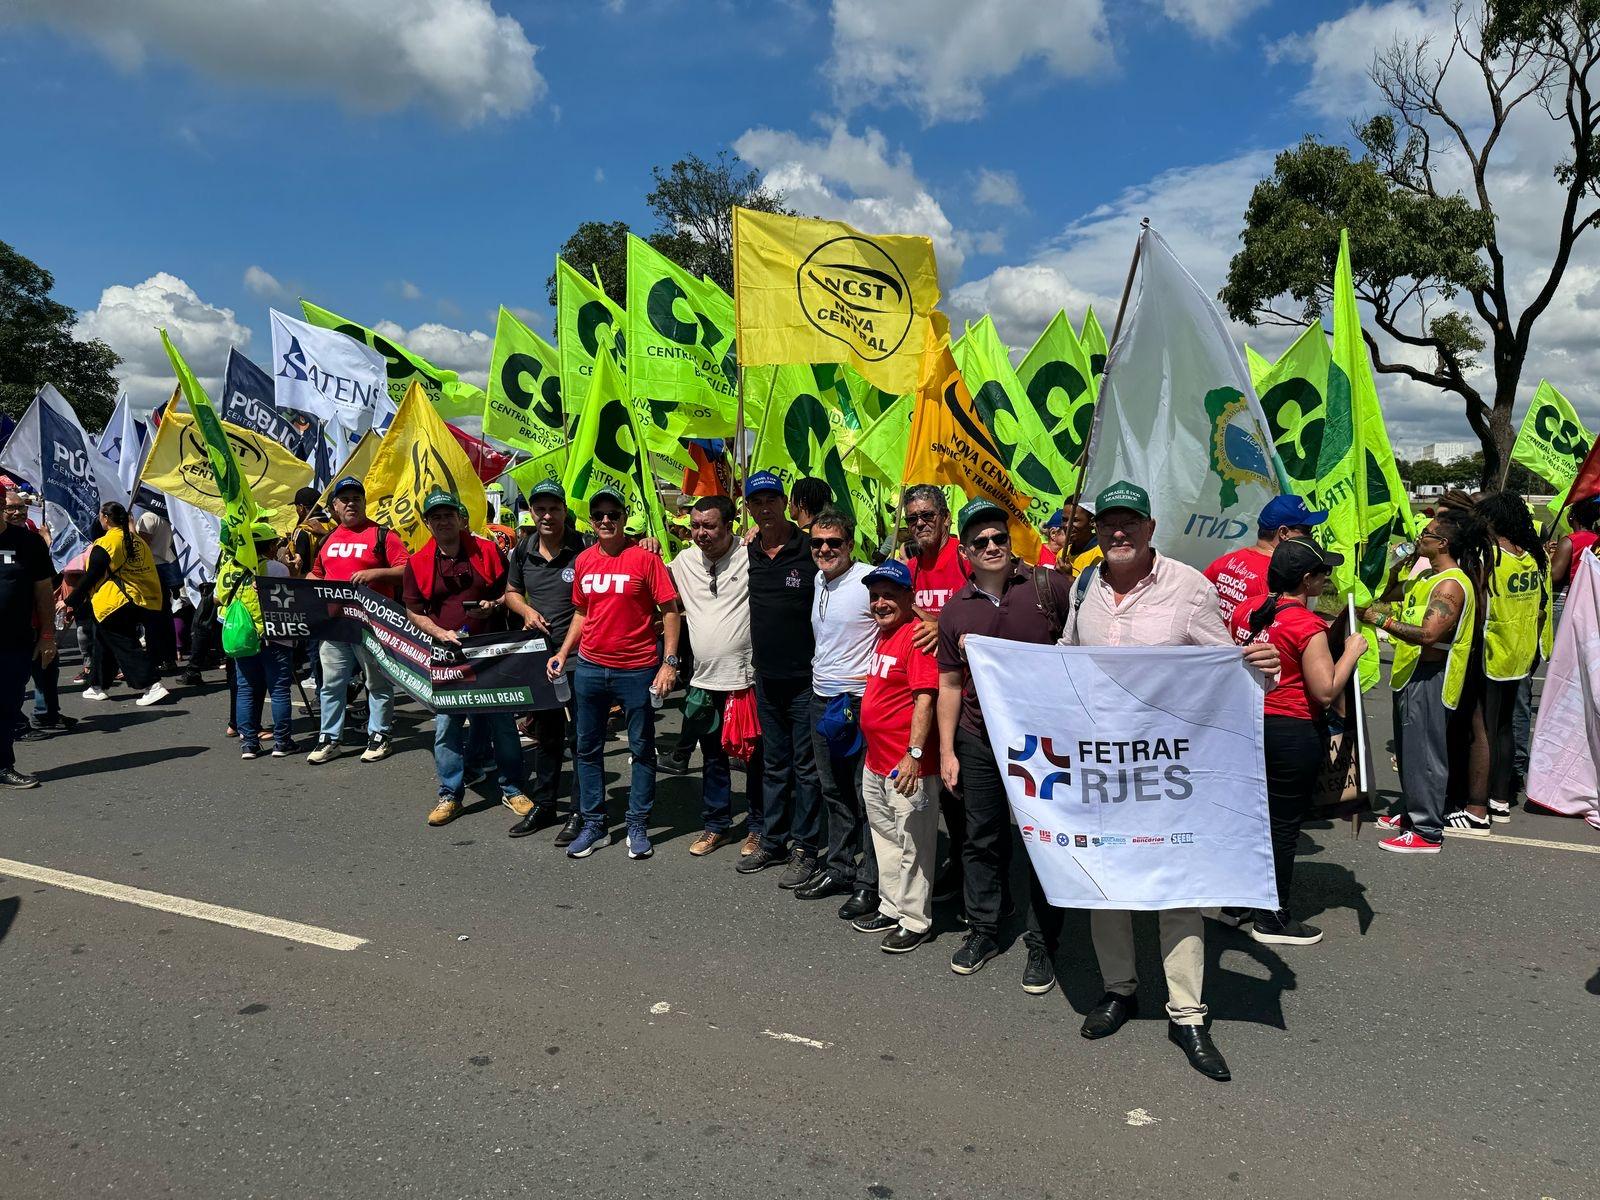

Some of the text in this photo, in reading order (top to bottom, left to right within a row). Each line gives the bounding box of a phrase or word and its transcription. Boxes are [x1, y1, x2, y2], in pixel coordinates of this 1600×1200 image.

[825, 277, 887, 301] NCST
[835, 300, 874, 333] NOVA
[817, 308, 888, 353] CENTRAL
[702, 360, 725, 378] DO
[490, 400, 533, 427] CENTRAL
[951, 432, 980, 466] NOVA
[326, 543, 368, 558] CUT
[581, 573, 630, 594] CUT
[1217, 572, 1247, 592] REDUÇÃO
[1507, 571, 1539, 594] CSB
[915, 589, 949, 608] CUT
[264, 611, 307, 623] FETRAF
[265, 621, 311, 637] RJES
[432, 667, 464, 680] SALÁRIO
[459, 691, 474, 706] ATÉ
[474, 693, 497, 705] 5MIL
[496, 691, 525, 704] REAIS
[1078, 738, 1190, 764] FETRAF
[1080, 764, 1194, 804] RJES
